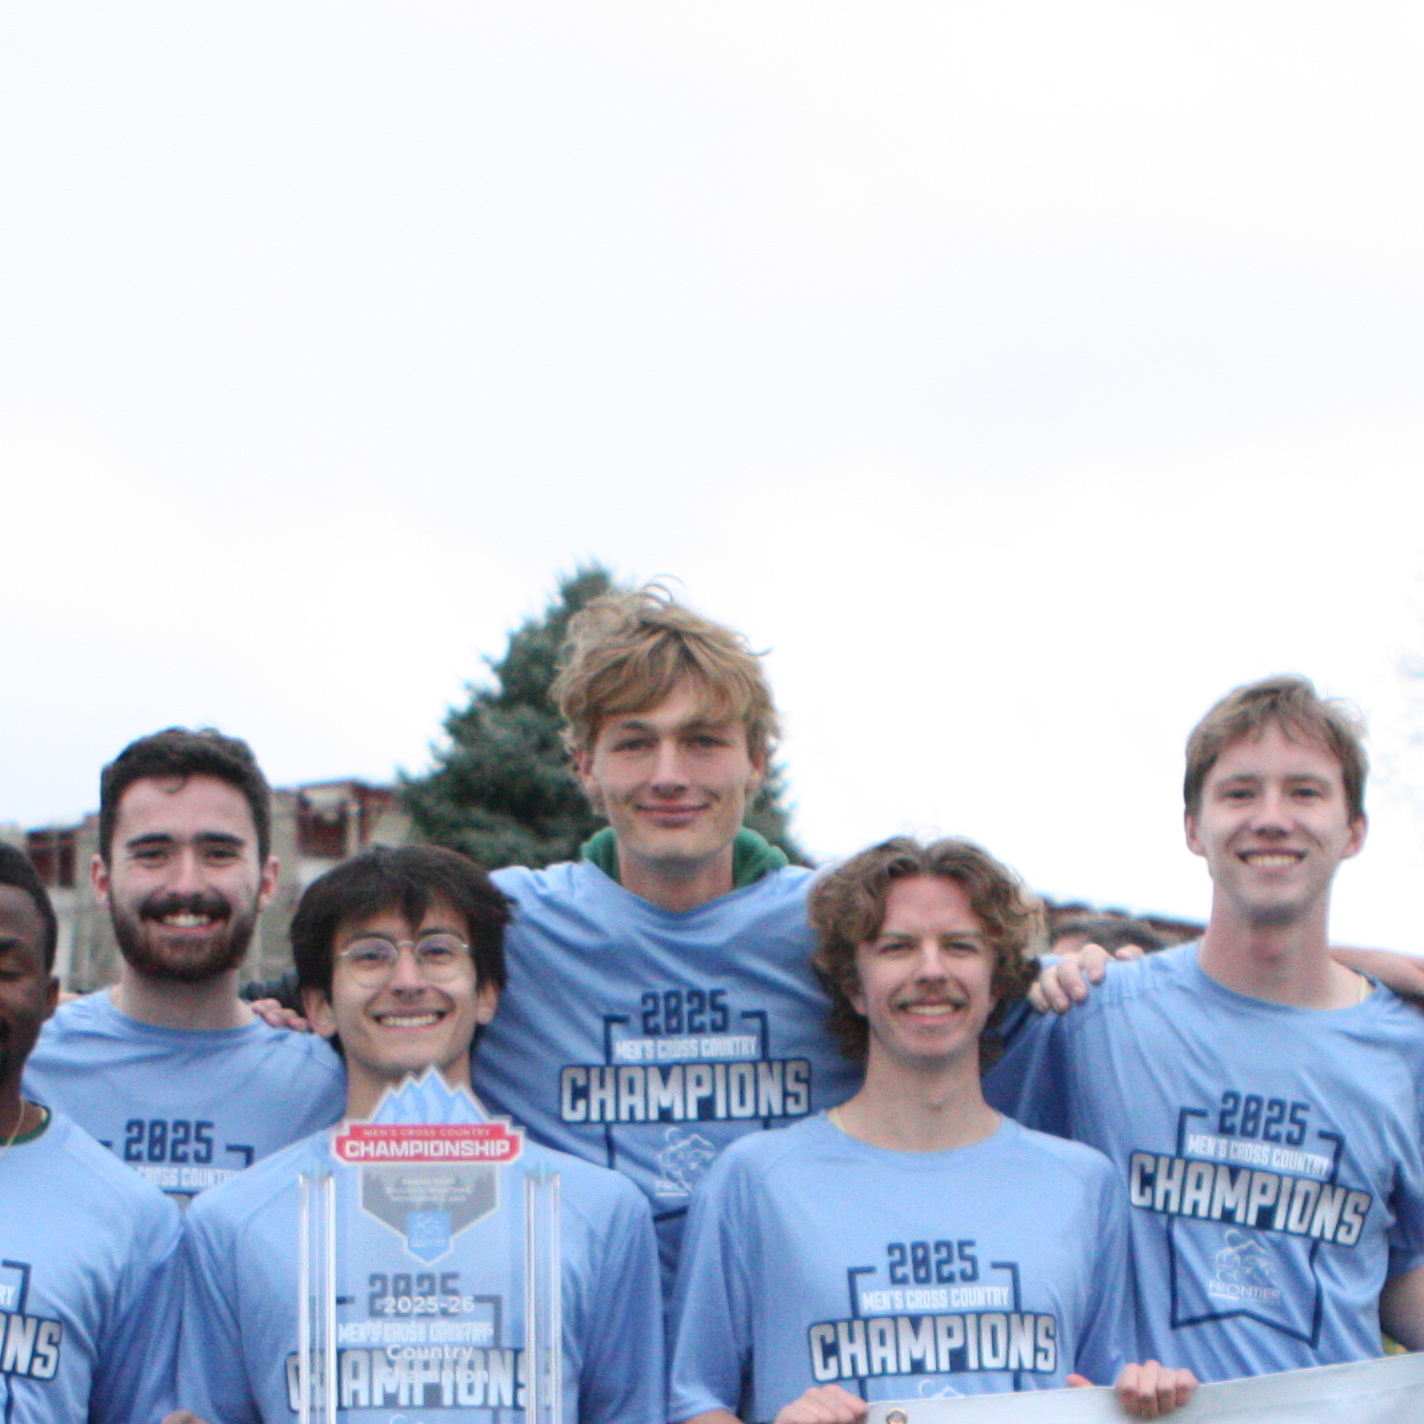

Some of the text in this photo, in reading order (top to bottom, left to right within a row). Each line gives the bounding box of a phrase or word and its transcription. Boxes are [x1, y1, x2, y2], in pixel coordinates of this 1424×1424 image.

[641, 989, 730, 1035] 2025
[561, 1058, 812, 1122] CHAMPIONS
[1219, 1090, 1310, 1146] 2025
[124, 1118, 214, 1164] 2025
[345, 1140, 511, 1158] CHAMPIONSHIP
[1229, 1140, 1270, 1165] CROSS
[1272, 1148, 1329, 1176] COUNTRY
[1130, 1152, 1372, 1247] CHAMPIONS
[887, 1240, 980, 1285] 2025
[383, 1296, 474, 1314] 2025-26
[906, 1288, 948, 1310] CROSS
[951, 1286, 1008, 1308] COUNTRY
[386, 1344, 473, 1364] Country
[809, 1312, 1056, 1382] CHAMPIONS
